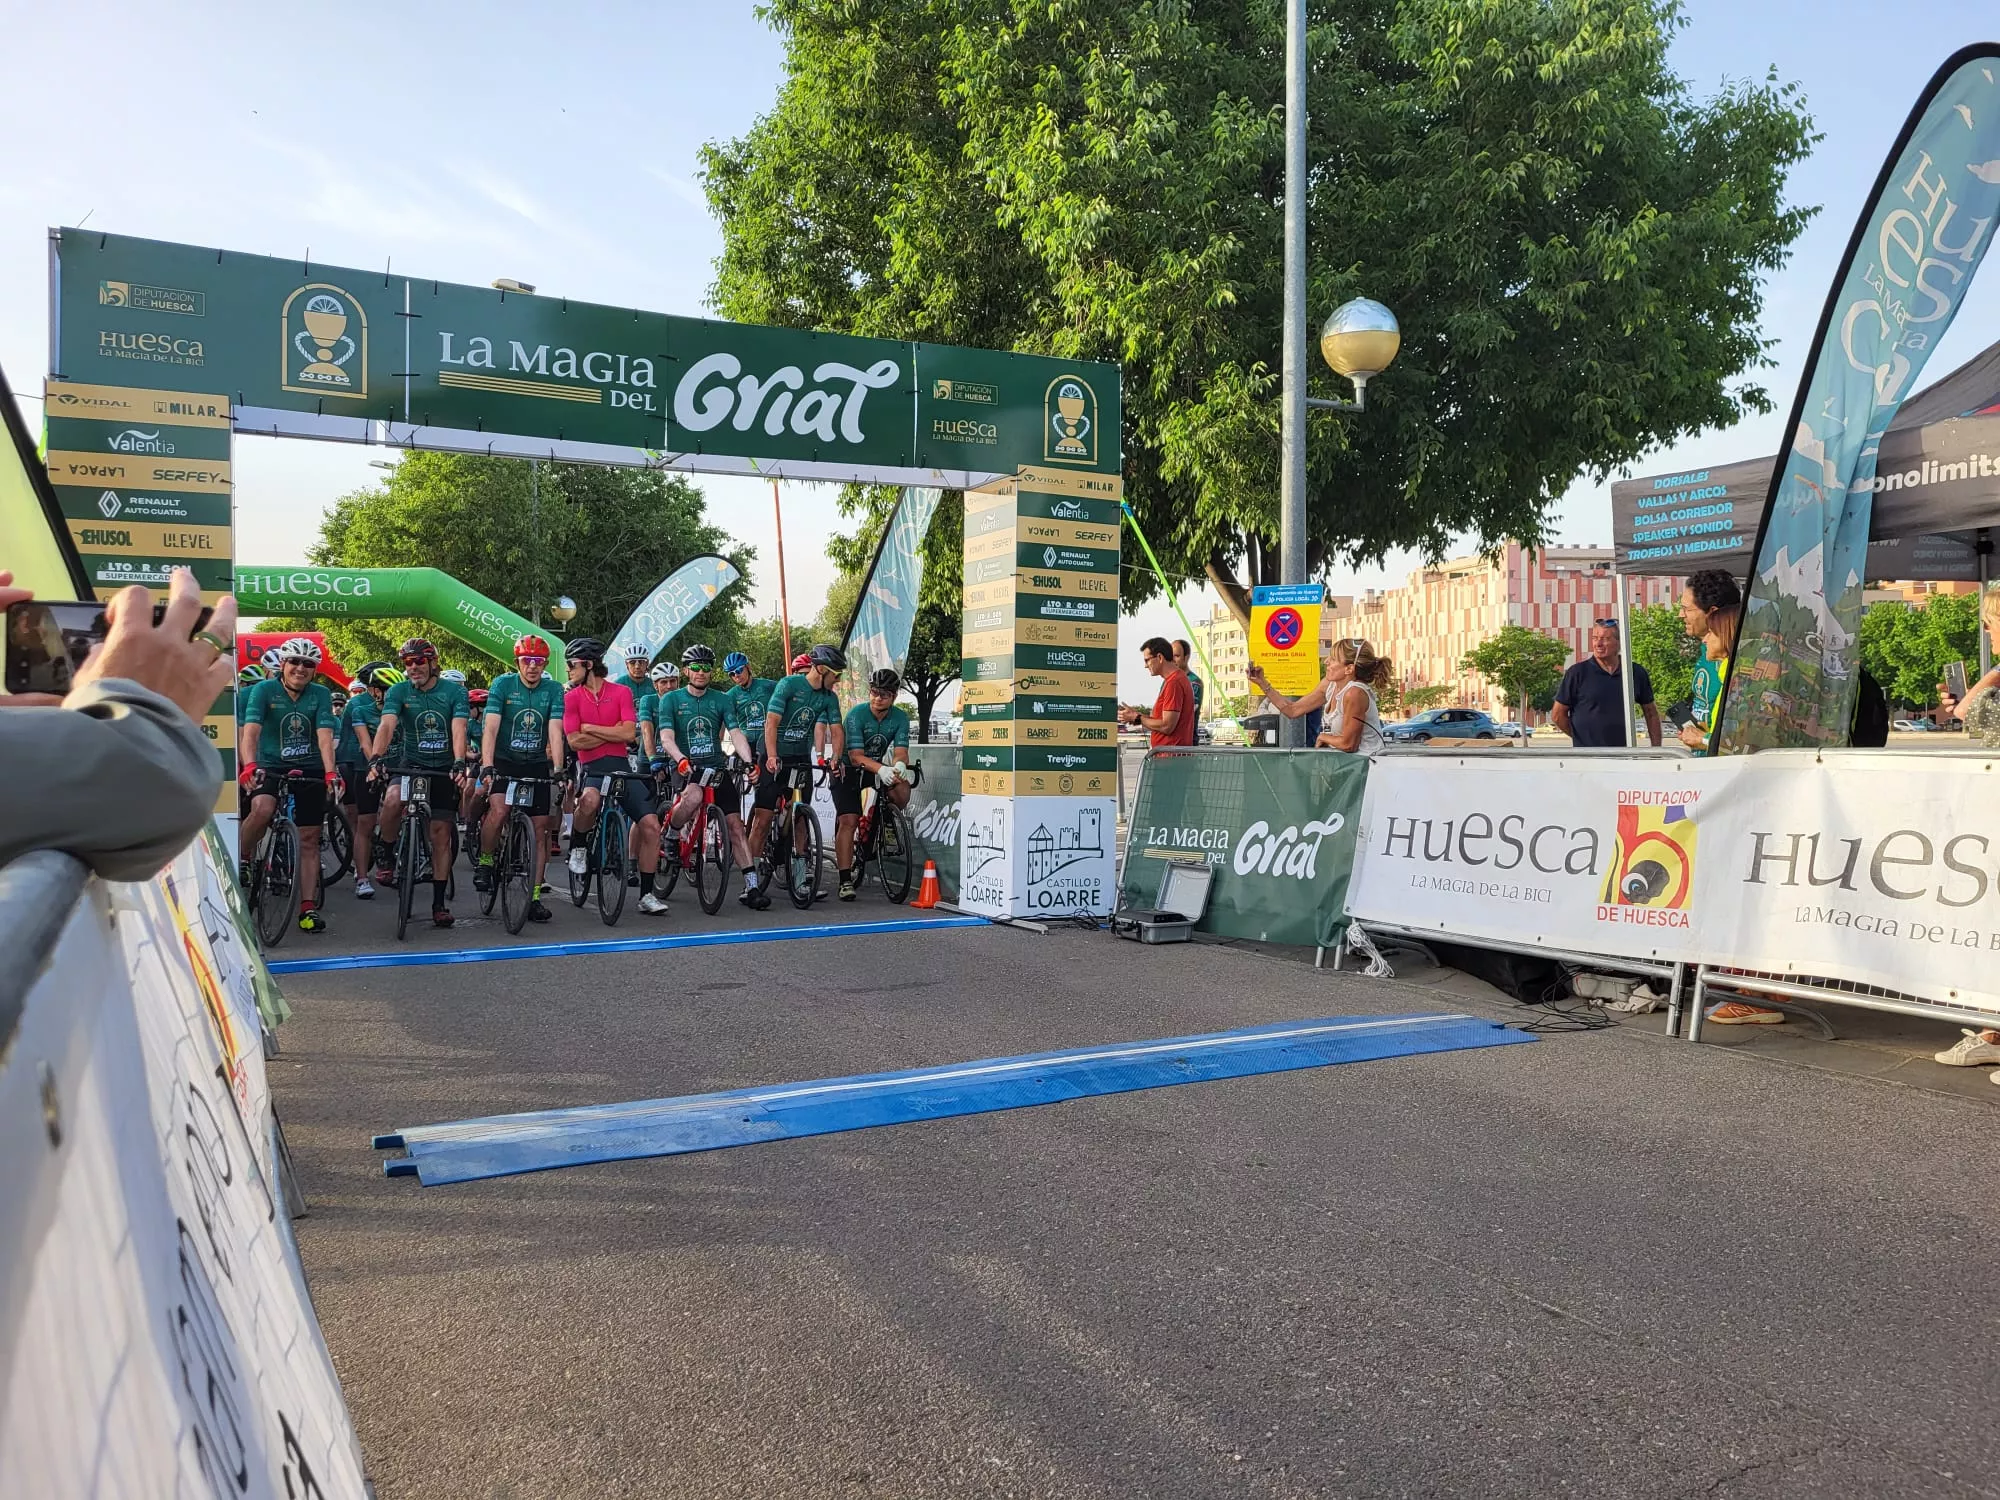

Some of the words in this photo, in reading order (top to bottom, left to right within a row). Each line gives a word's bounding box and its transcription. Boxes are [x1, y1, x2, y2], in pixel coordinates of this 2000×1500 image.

[134, 297, 148, 307] DE
[151, 299, 195, 312] HUESCA
[955, 391, 965, 399] DE
[965, 393, 992, 402] HUESCA
[81, 397, 132, 408] VIDAL
[169, 402, 217, 417] MILAR
[107, 429, 176, 455] Valentia
[153, 469, 220, 483] SERFEY
[1037, 477, 1066, 485] VIDAL
[1086, 481, 1114, 492] MILAR
[1654, 471, 1710, 490] DORSALES
[129, 497, 182, 507] RENAULT
[1638, 493, 1677, 509] VALLAS
[1679, 492, 1688, 503] Y
[1689, 485, 1727, 501] ARCOS
[1051, 501, 1089, 520] Valentia
[1634, 511, 1669, 527] BOLSA
[1670, 502, 1733, 521] CORREDOR
[1075, 531, 1114, 542] SERFEY
[1633, 527, 1679, 543] SPEAKER
[1680, 526, 1688, 536] Y
[1689, 519, 1733, 535] SONIDO
[1060, 551, 1091, 560] RENAULT
[1627, 544, 1673, 560] TROFEOS
[1675, 543, 1683, 555] Y
[1685, 536, 1744, 554] MEDALLAS
[105, 572, 171, 582] SUPERMERCAD
[1083, 631, 1105, 640] Pedro
[1077, 728, 1108, 740] 226ERS
[1047, 754, 1087, 767] Trevijano
[1617, 789, 1702, 807] DIPUTACION
[1381, 812, 1599, 876] Huesca
[1046, 878, 1091, 888] CASTILLO
[966, 883, 1004, 907] LOARRE
[1027, 889, 1101, 908] LOARRE
[1523, 887, 1551, 904] BICI
[1596, 906, 1618, 923] DE
[1624, 907, 1690, 928] HUESCA
